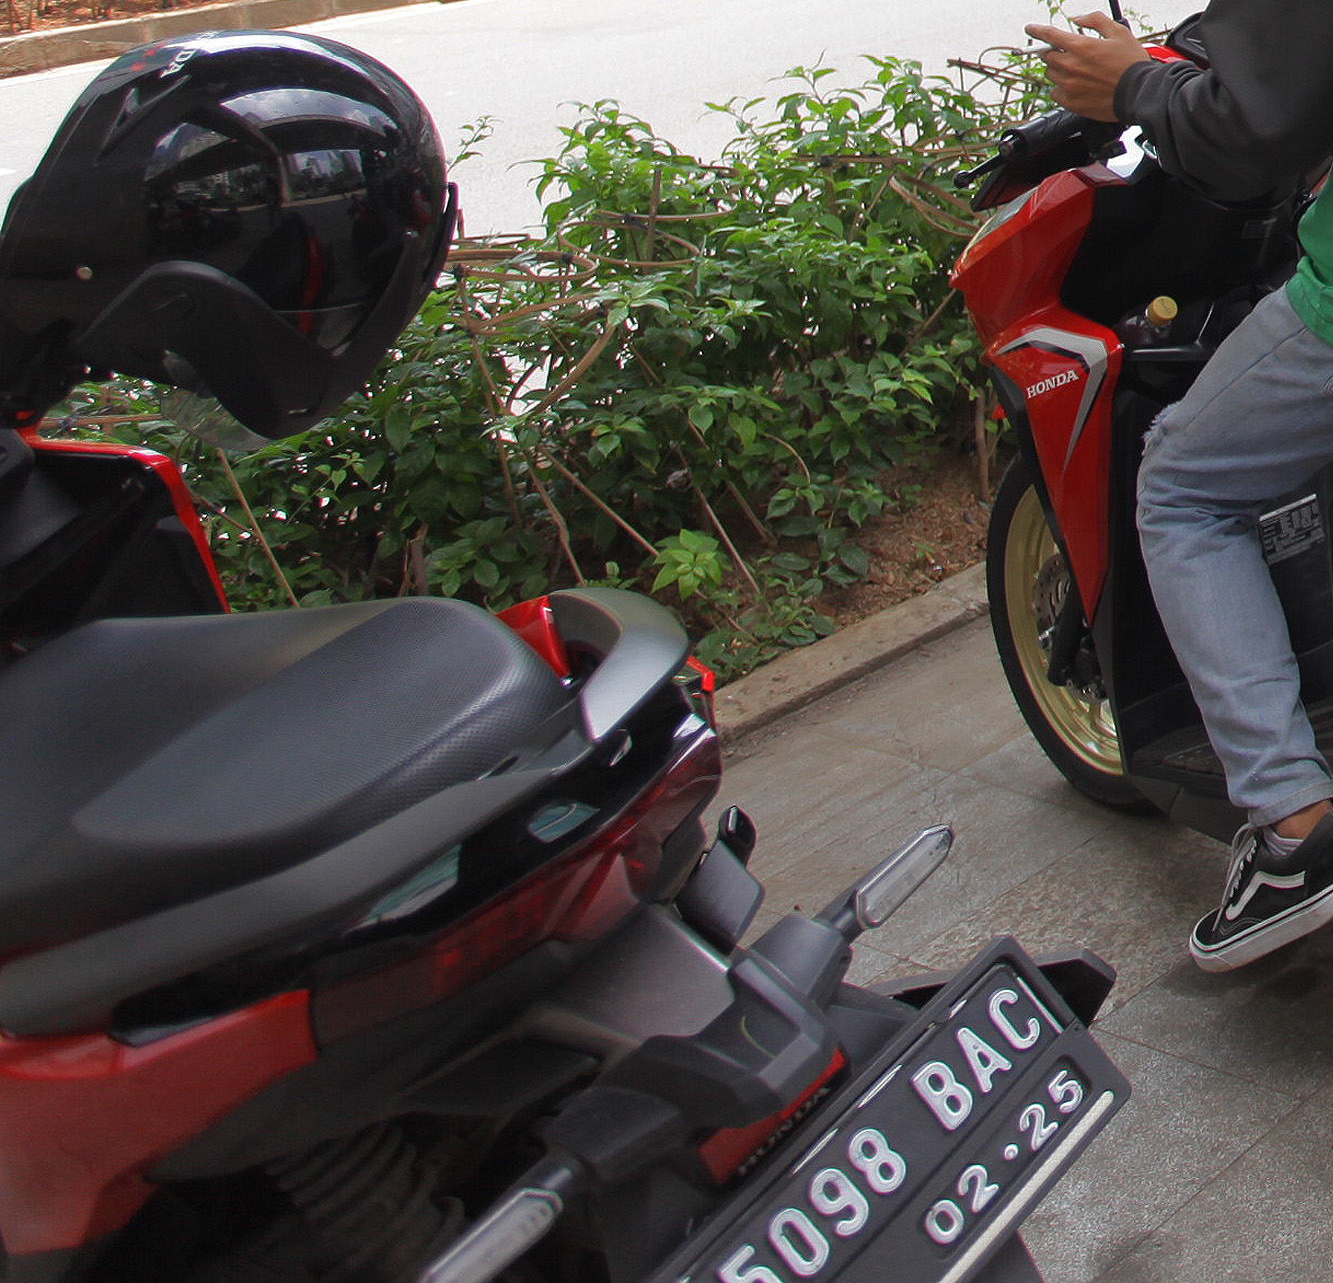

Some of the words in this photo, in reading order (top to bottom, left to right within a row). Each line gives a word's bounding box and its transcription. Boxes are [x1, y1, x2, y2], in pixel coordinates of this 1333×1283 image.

[1026, 370, 1079, 399] HONDA
[911, 988, 1041, 1131] BAC
[716, 1128, 907, 1283] 5098
